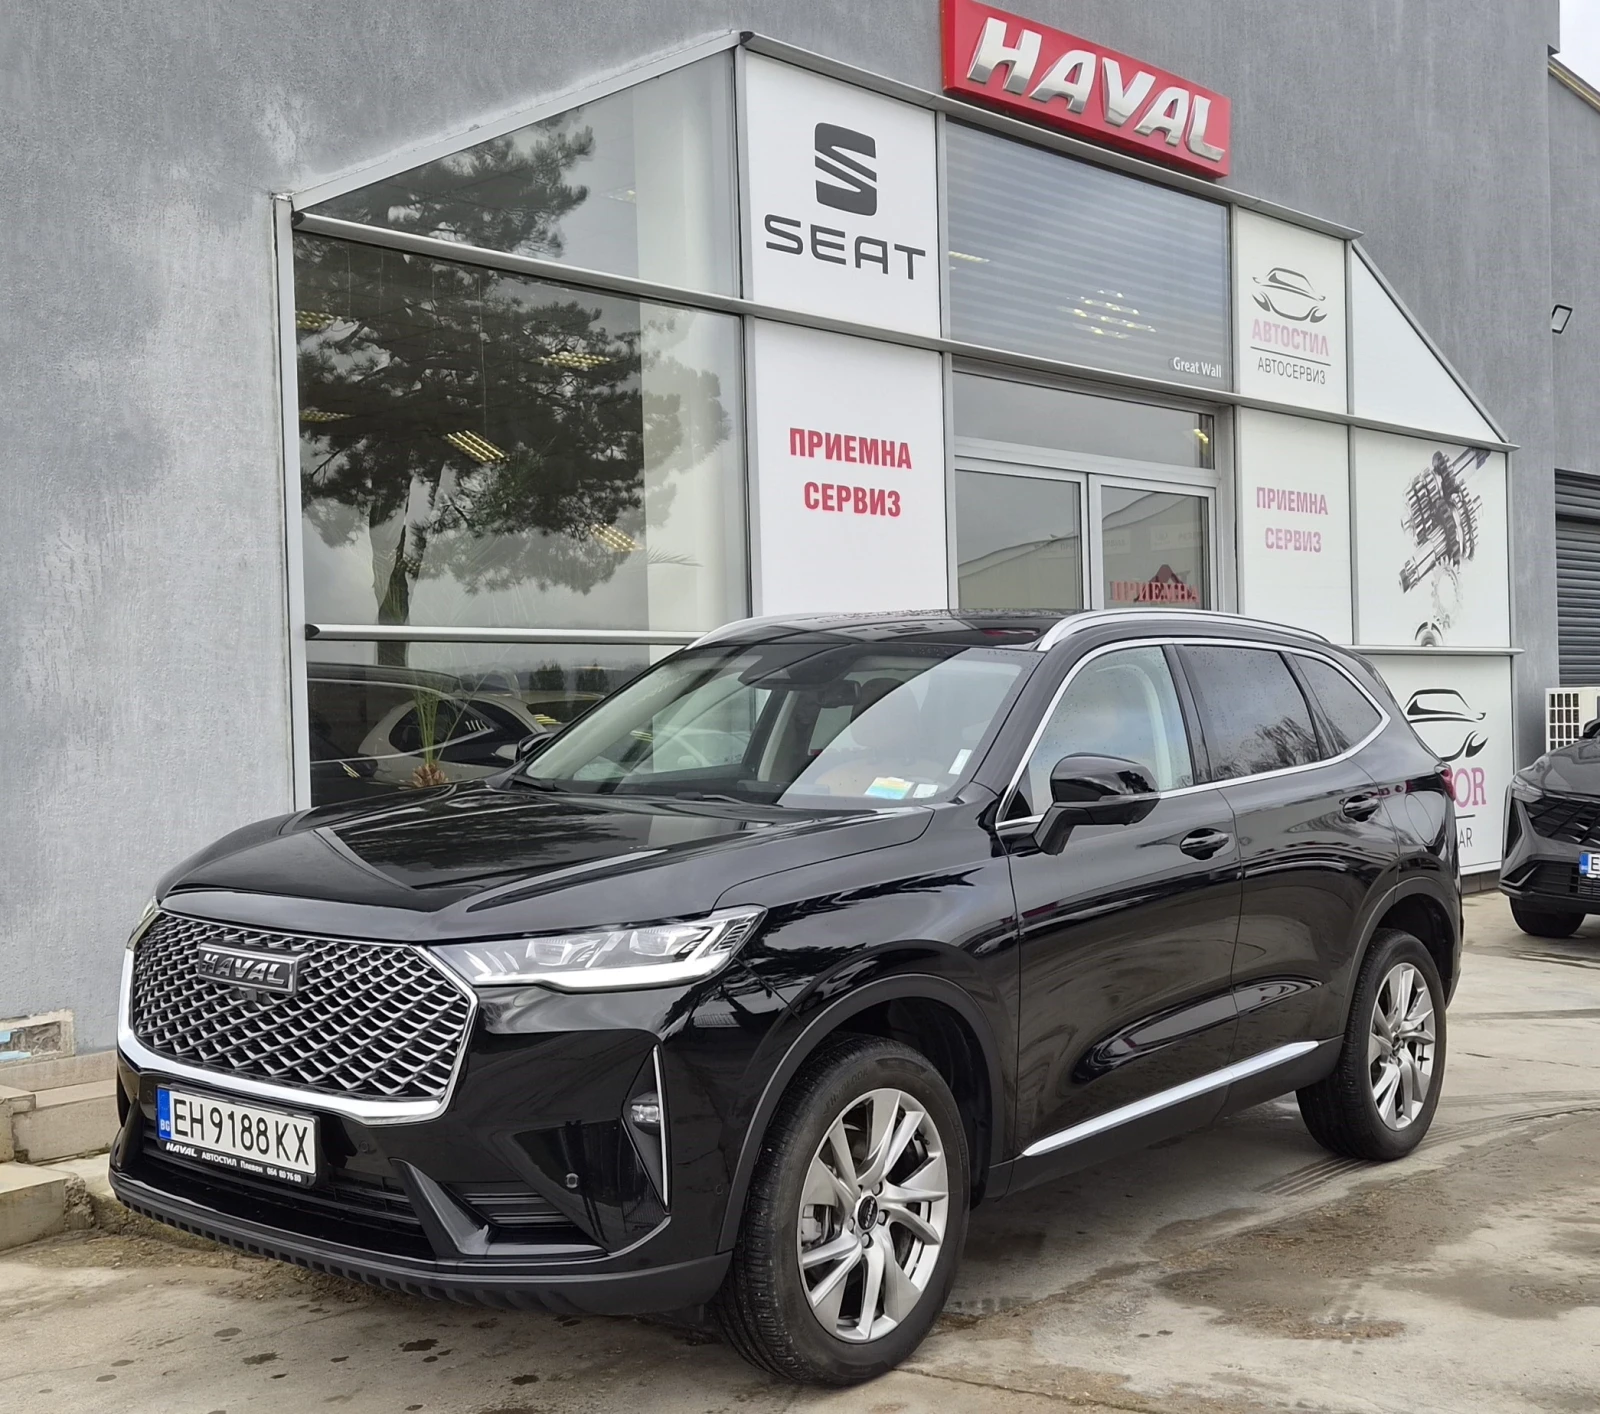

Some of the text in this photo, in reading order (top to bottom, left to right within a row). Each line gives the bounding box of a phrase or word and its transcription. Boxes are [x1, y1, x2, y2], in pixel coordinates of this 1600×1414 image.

[966, 17, 1225, 162] HAVAL
[764, 214, 926, 281] SEAT
[1252, 318, 1329, 357] АВТОСТИЛ
[1173, 356, 1222, 378] Great Wall
[1258, 356, 1326, 385] АВТОСЕРВИЗ
[789, 427, 912, 469] ПРИЕМНА
[804, 481, 901, 518] СЕРВИЗ
[1256, 486, 1329, 516] ПРИЕМНА
[1265, 527, 1322, 553] СЕРВИЗ
[1110, 581, 1200, 603] ПРИЕМНА
[202, 953, 285, 985] HAVAL
[160, 1119, 171, 1131] BG
[165, 1142, 197, 1158] HAVAL
[201, 1151, 237, 1167] АВТОСТИЛ
